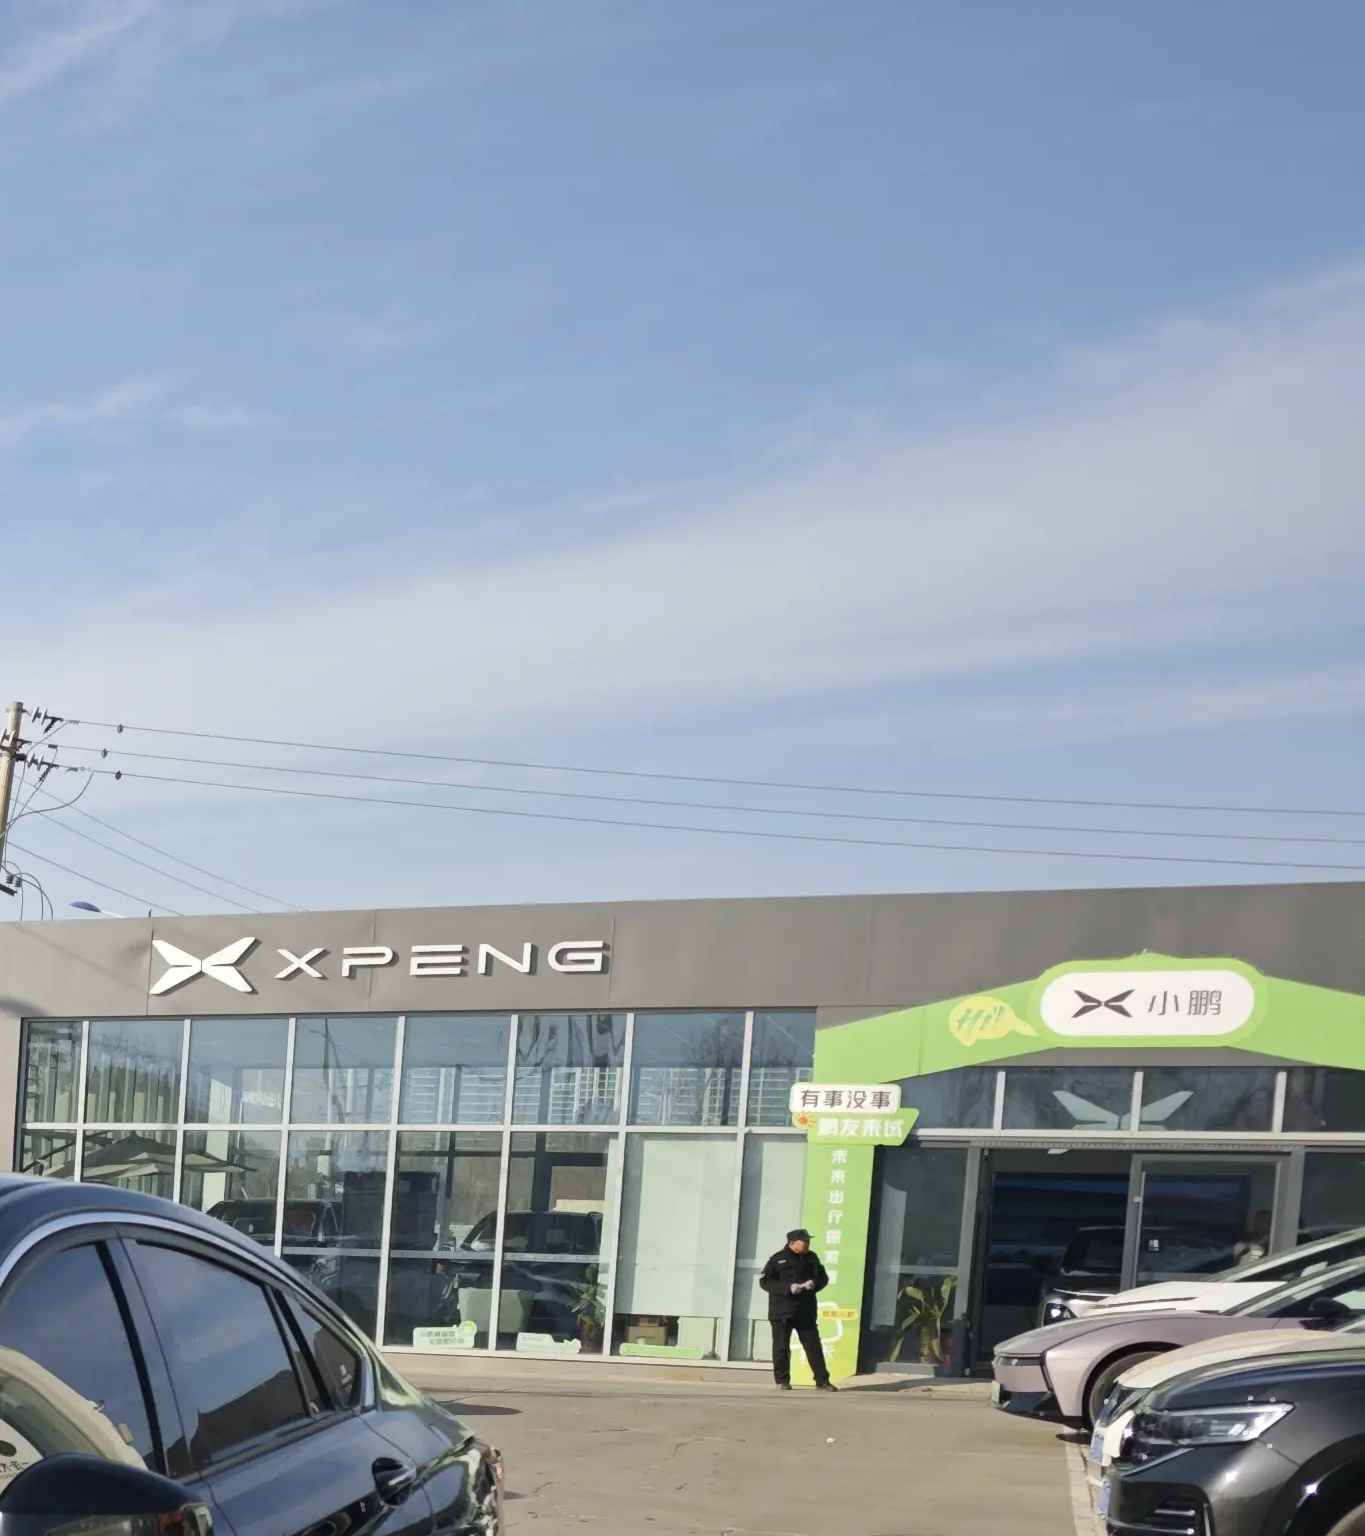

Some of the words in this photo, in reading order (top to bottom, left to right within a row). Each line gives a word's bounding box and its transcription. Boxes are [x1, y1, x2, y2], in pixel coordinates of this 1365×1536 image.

[275, 940, 604, 979] XPENG
[1147, 990, 1223, 1016] 小鹏
[800, 1089, 892, 1110] 有事没事
[817, 1117, 904, 1138] 鹏友来试
